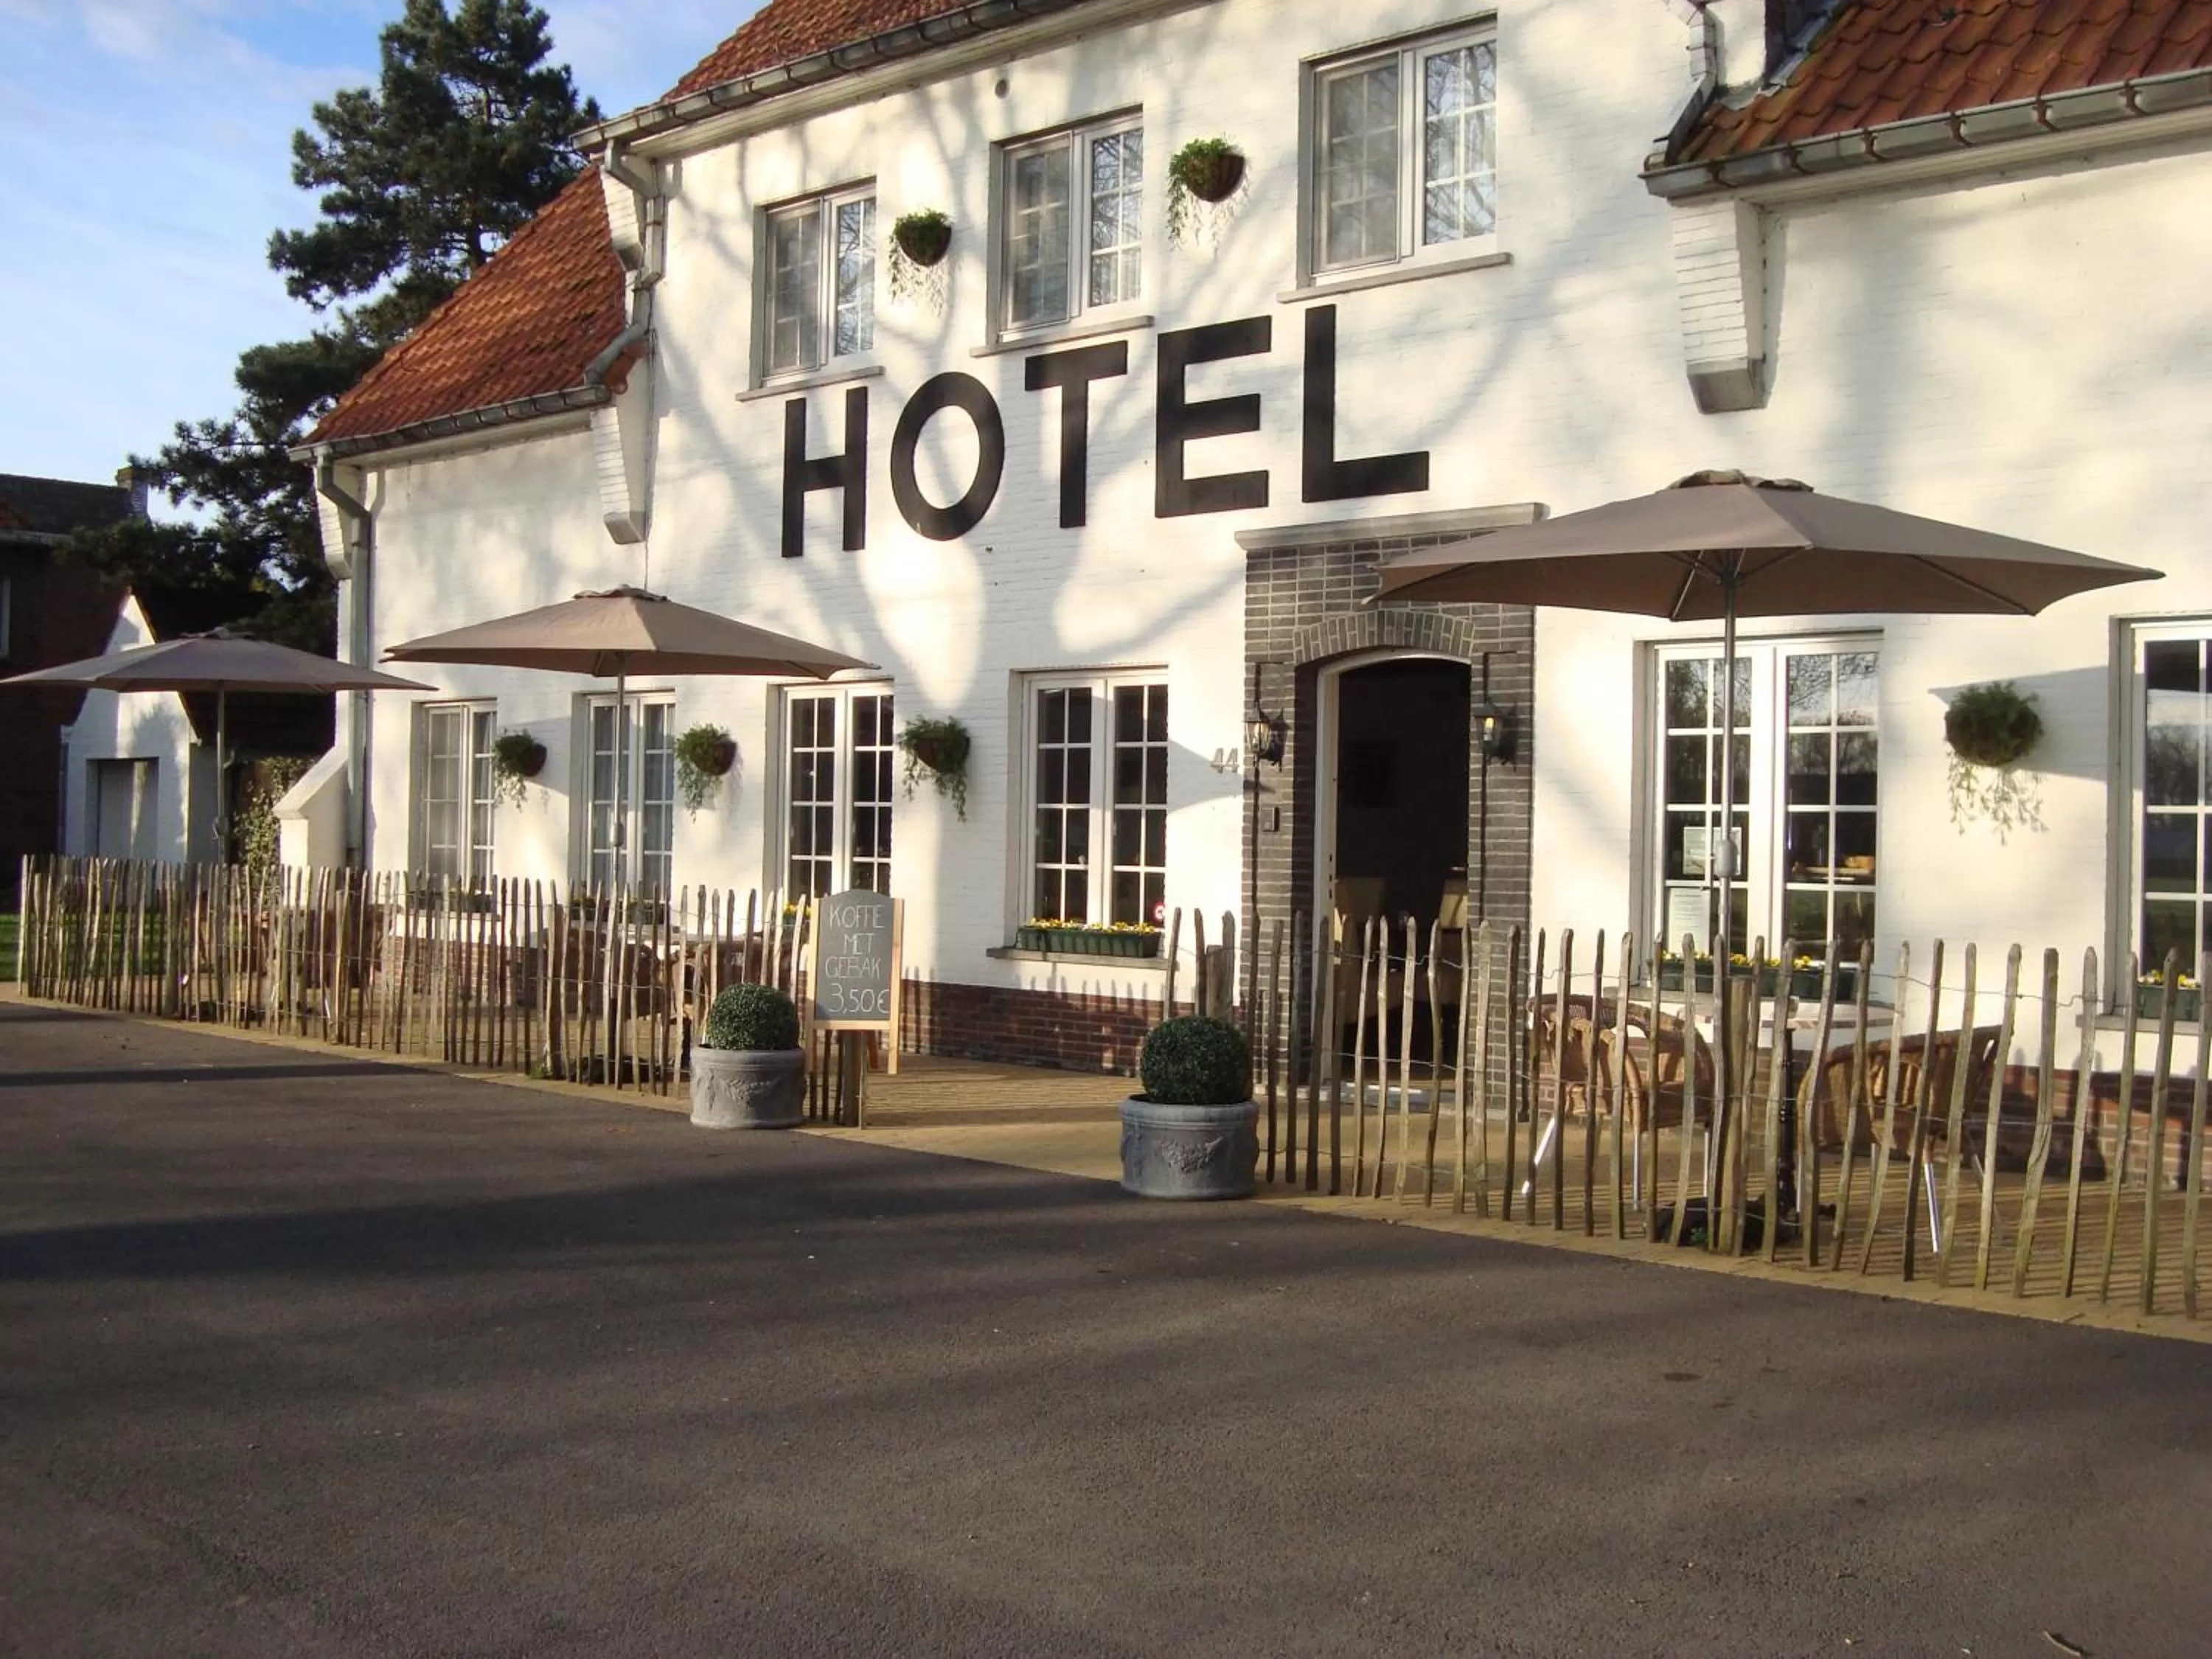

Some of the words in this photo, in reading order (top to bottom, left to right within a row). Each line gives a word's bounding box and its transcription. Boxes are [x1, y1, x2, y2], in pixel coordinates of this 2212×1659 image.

[782, 304, 1429, 558] HOTEL
[1210, 747, 1239, 773] 44
[824, 956, 881, 980] GEBAK
[827, 982, 890, 1015] 3,50€
